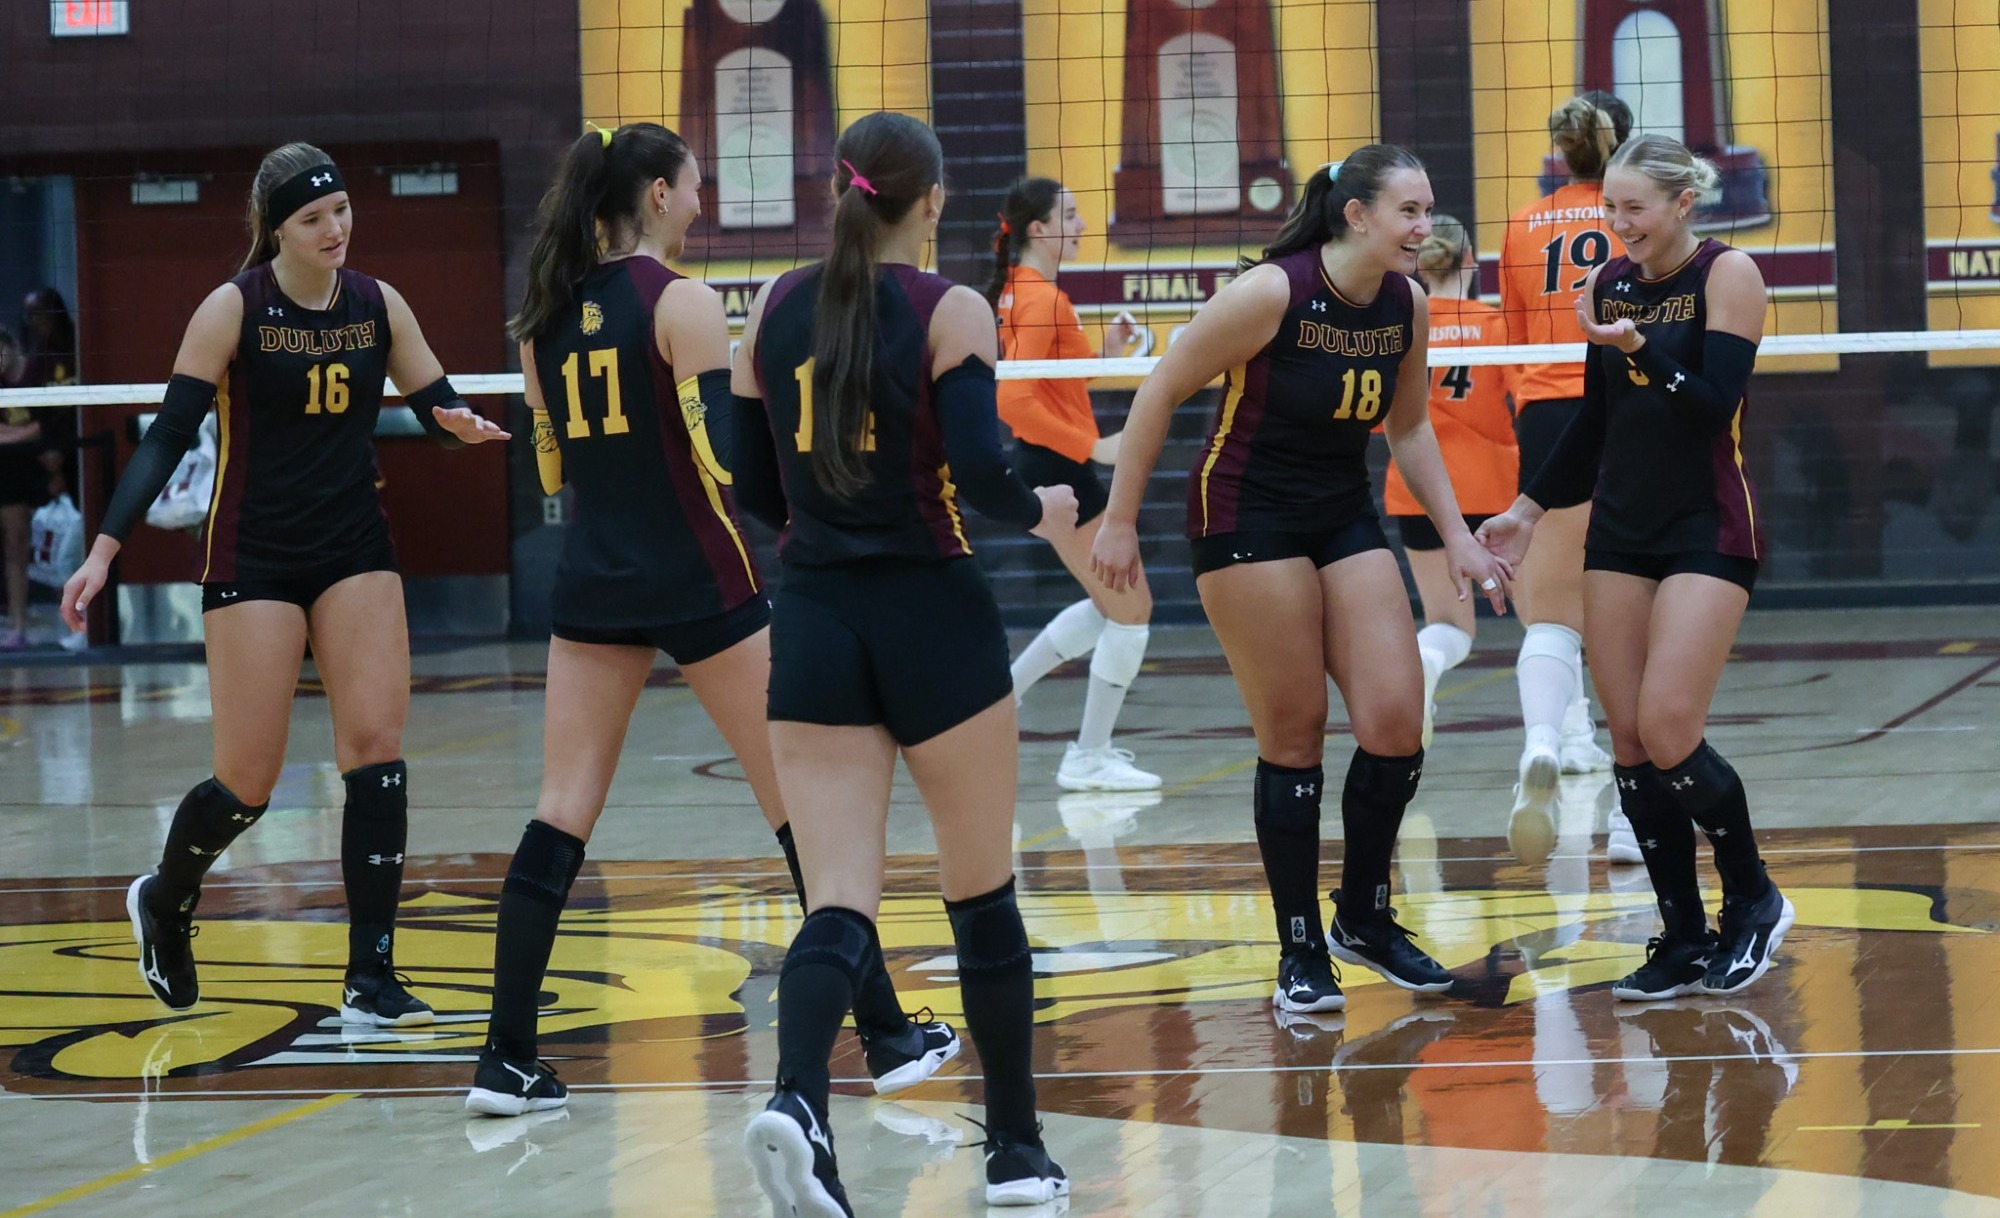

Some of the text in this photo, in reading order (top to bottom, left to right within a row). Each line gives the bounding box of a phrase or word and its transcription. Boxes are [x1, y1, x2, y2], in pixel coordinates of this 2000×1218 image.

[1528, 205, 1606, 233] JAMESTOW
[1540, 229, 1611, 296] 19
[1122, 273, 1206, 301] FINAL
[259, 320, 377, 355] DULUTH
[1298, 320, 1404, 357] DULUTH
[1429, 325, 1482, 342] ESTOWN
[304, 362, 350, 414] 16
[561, 347, 630, 439] 17
[1332, 368, 1382, 421] 18
[1428, 365, 1475, 401] 4
[794, 356, 876, 452] 1
